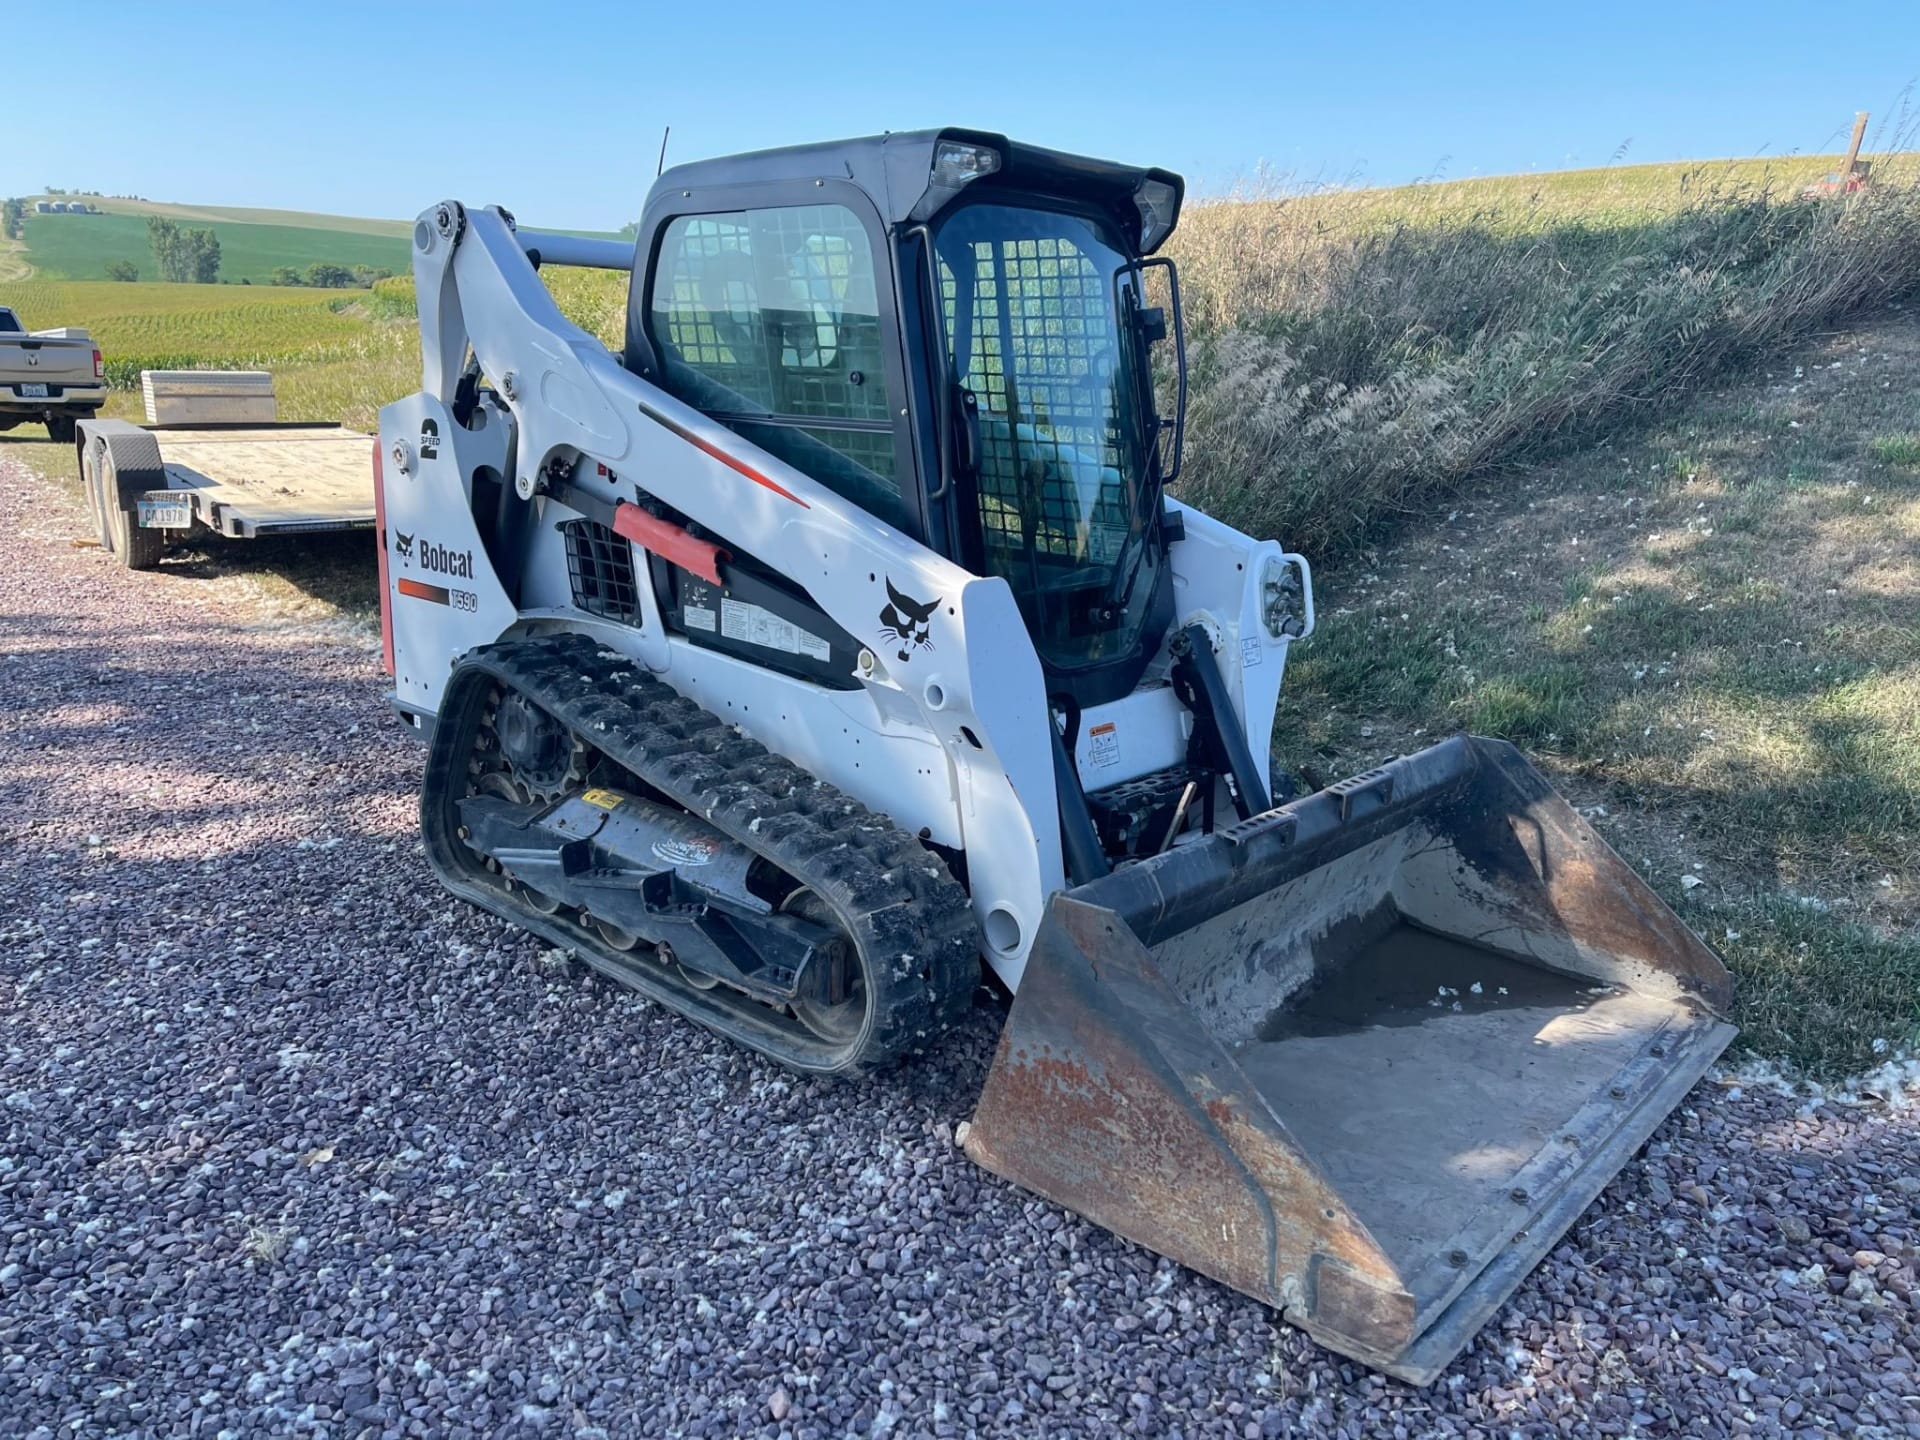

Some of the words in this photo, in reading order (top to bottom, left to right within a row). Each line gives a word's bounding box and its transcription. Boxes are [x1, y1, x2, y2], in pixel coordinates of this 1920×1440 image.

[420, 418, 439, 460] 2
[420, 435, 441, 447] SPEED
[420, 539, 474, 580] Bobcat
[451, 589, 478, 612] T590
